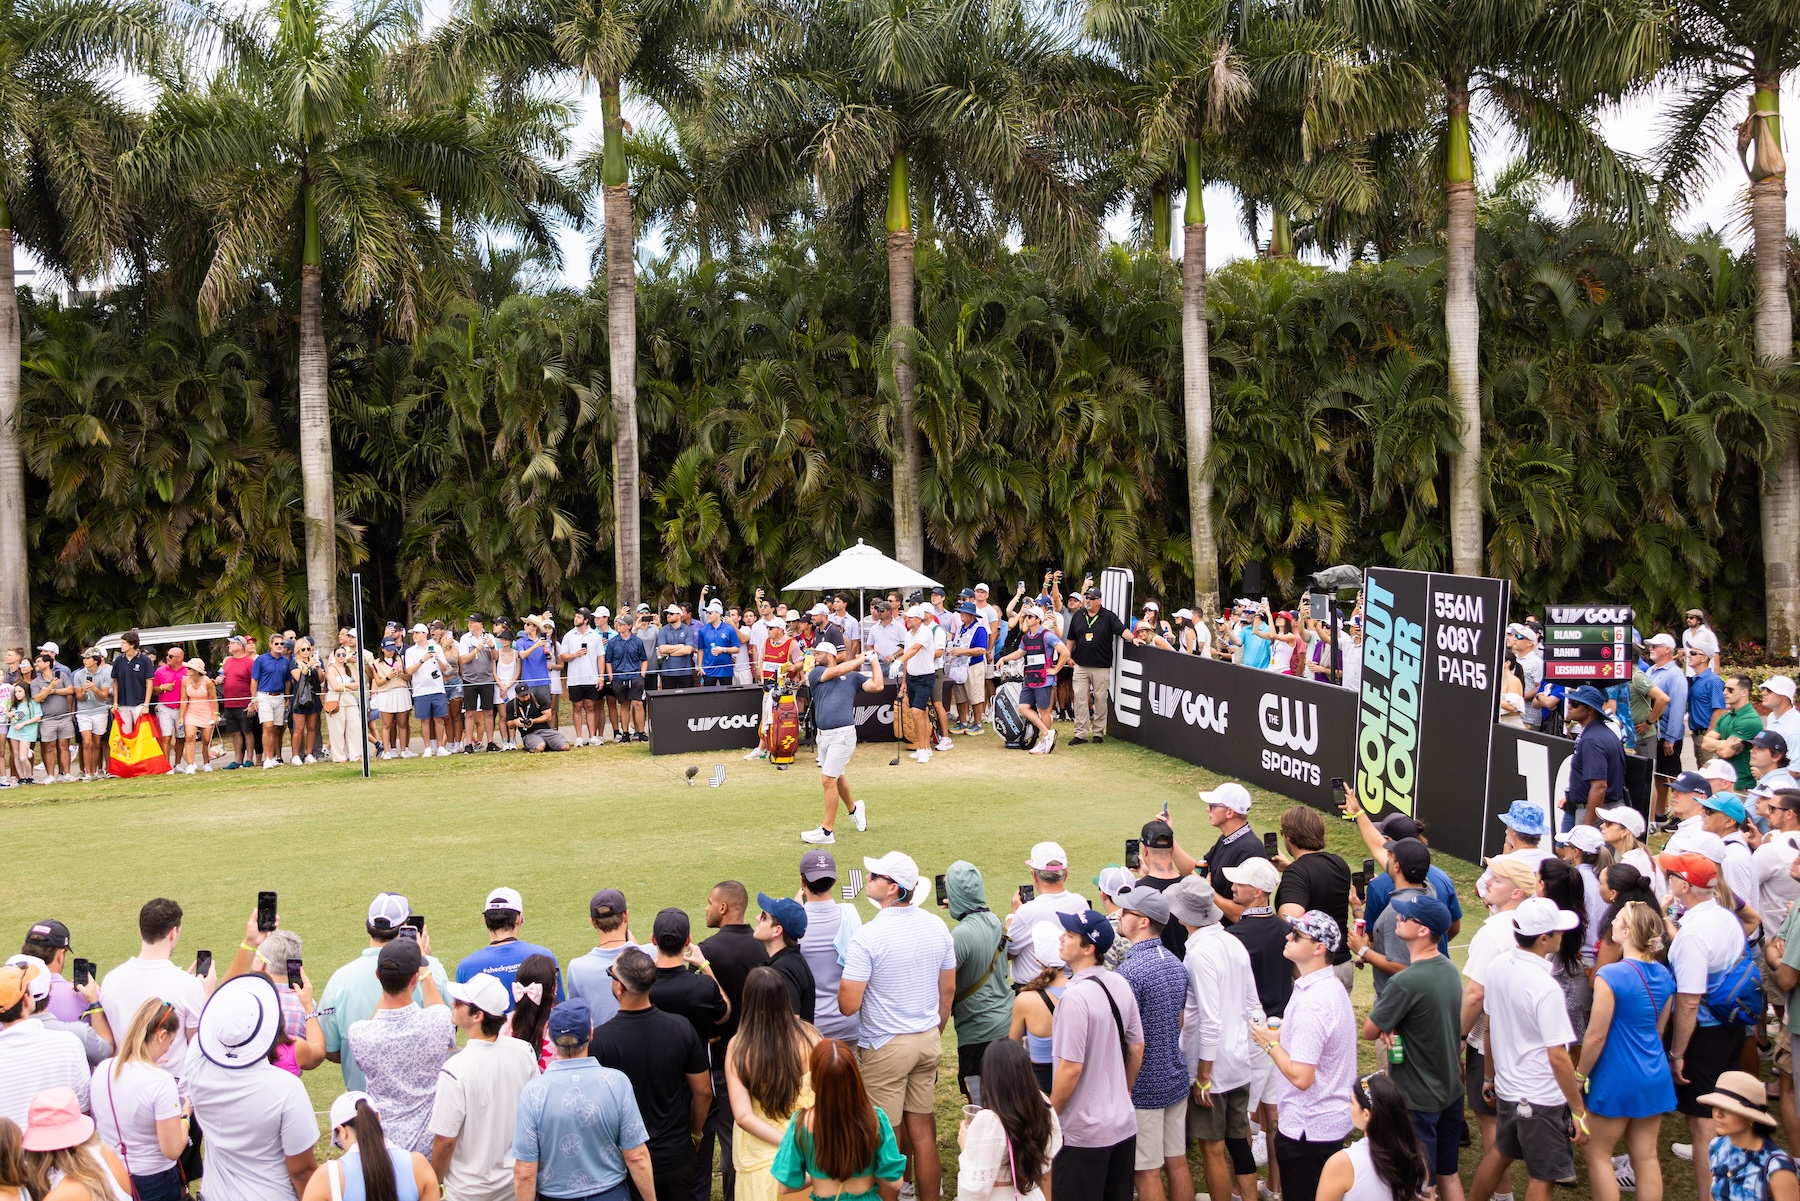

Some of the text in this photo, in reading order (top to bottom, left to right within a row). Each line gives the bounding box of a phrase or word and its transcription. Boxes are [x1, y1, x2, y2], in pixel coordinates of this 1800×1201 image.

[1434, 592, 1484, 624] 556M
[1363, 576, 1395, 679] BUT
[1436, 624, 1482, 656] 608Y
[1553, 630, 1583, 640] BLAND
[1615, 629, 1623, 641] 6
[1553, 647, 1580, 658] RAHM
[1615, 647, 1623, 658] 7
[1554, 665, 1596, 675] LEISHMAN
[1615, 664, 1623, 676] 5
[1258, 692, 1319, 756] CW
[1267, 712, 1280, 726] THE
[1385, 616, 1423, 818] LOUDER
[1261, 748, 1322, 787] SPORTS
